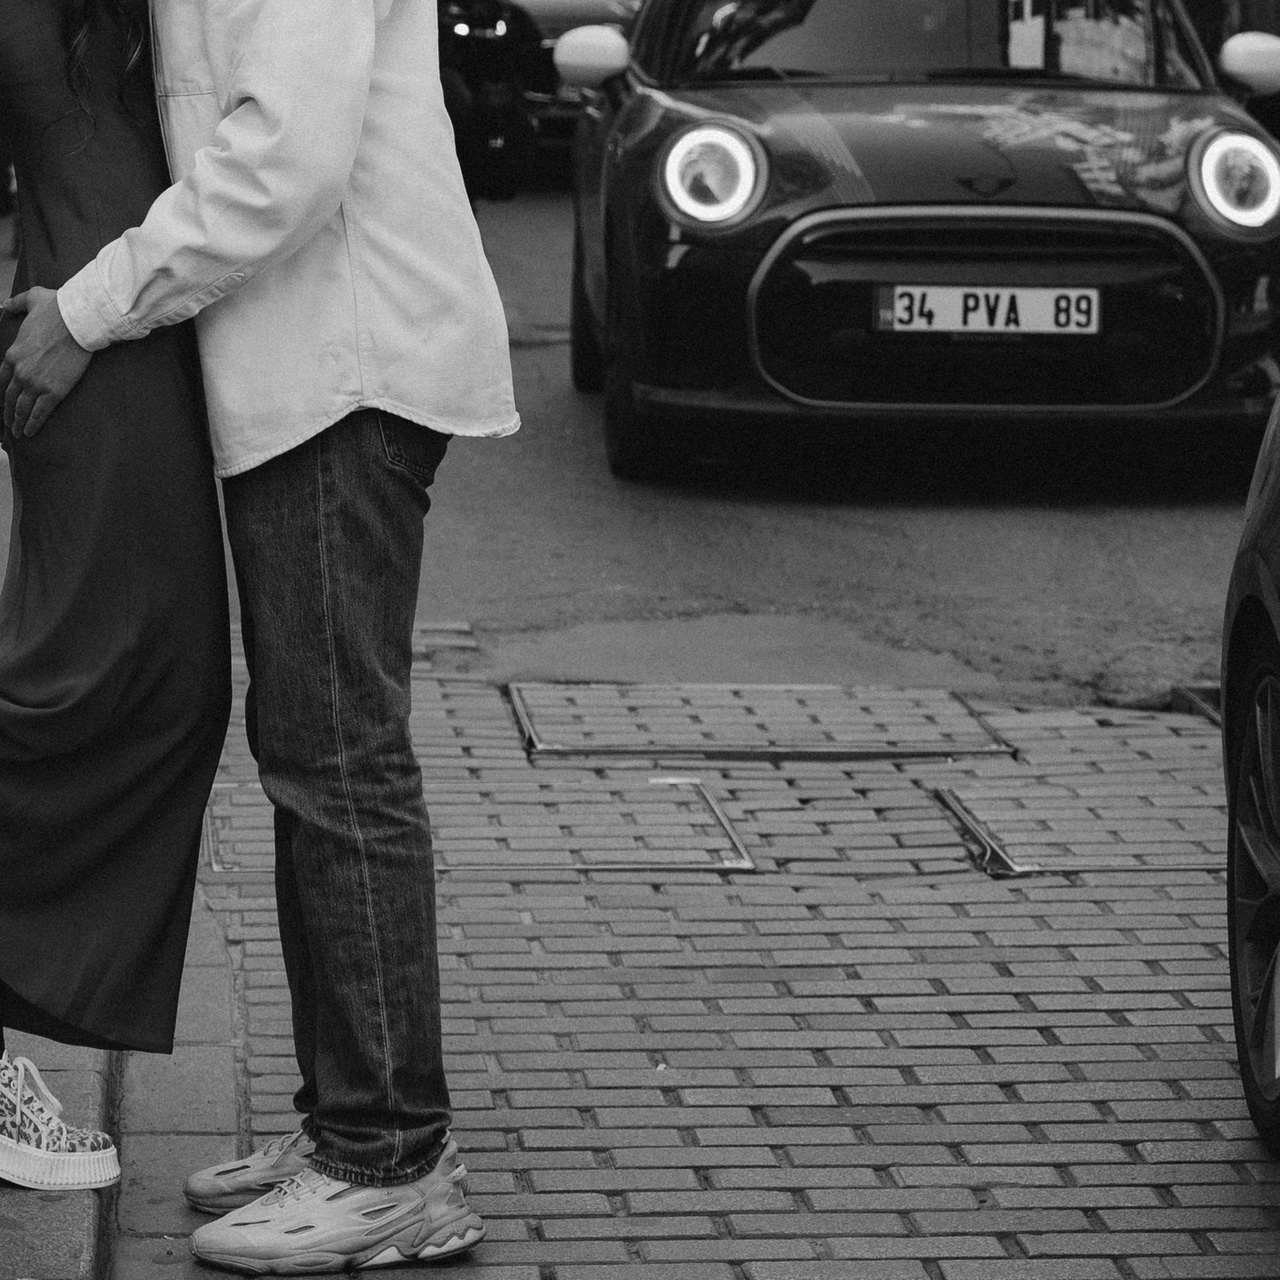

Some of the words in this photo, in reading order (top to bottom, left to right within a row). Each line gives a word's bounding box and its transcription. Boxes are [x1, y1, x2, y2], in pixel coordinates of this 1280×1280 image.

[898, 292, 934, 326] 34
[962, 293, 1019, 327] PVA
[1054, 294, 1092, 328] 89
